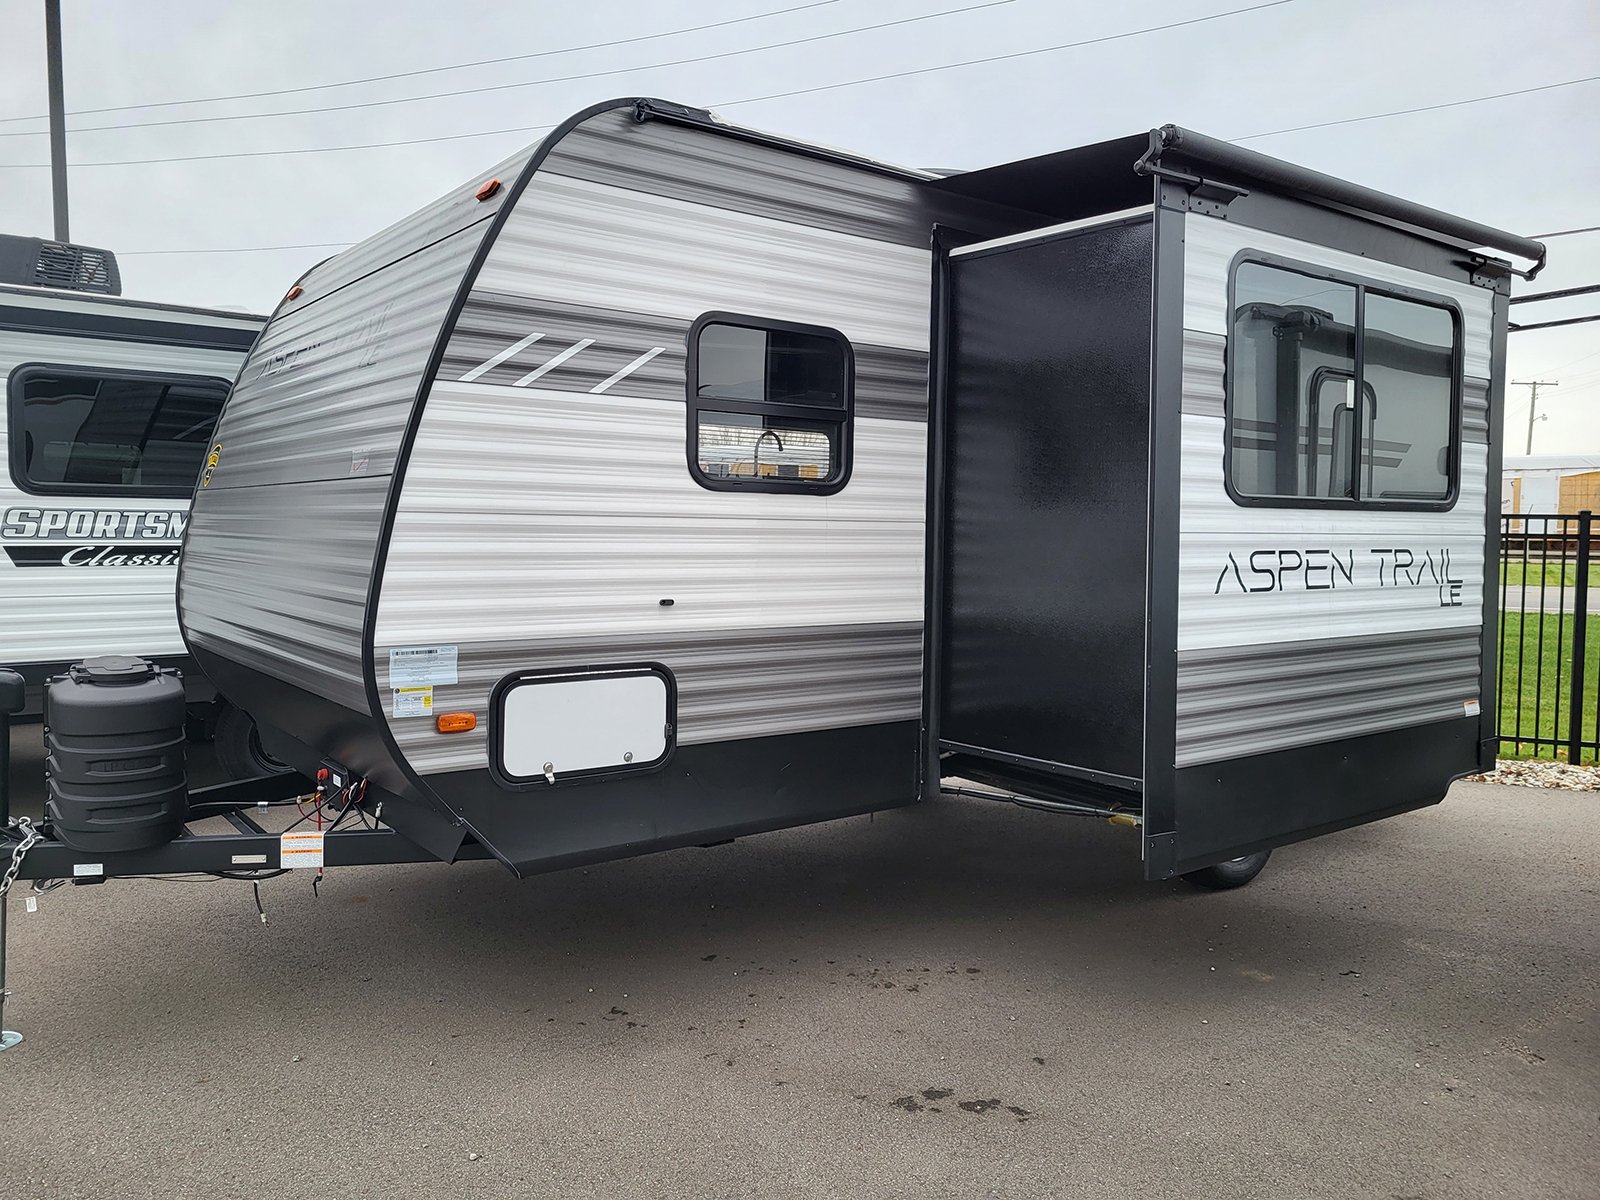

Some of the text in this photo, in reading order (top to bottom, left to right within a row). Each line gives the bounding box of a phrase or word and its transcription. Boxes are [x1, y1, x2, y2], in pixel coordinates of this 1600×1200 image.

[1214, 548, 1463, 594] ASPEN TRAIL
[1439, 585, 1463, 607] LE
